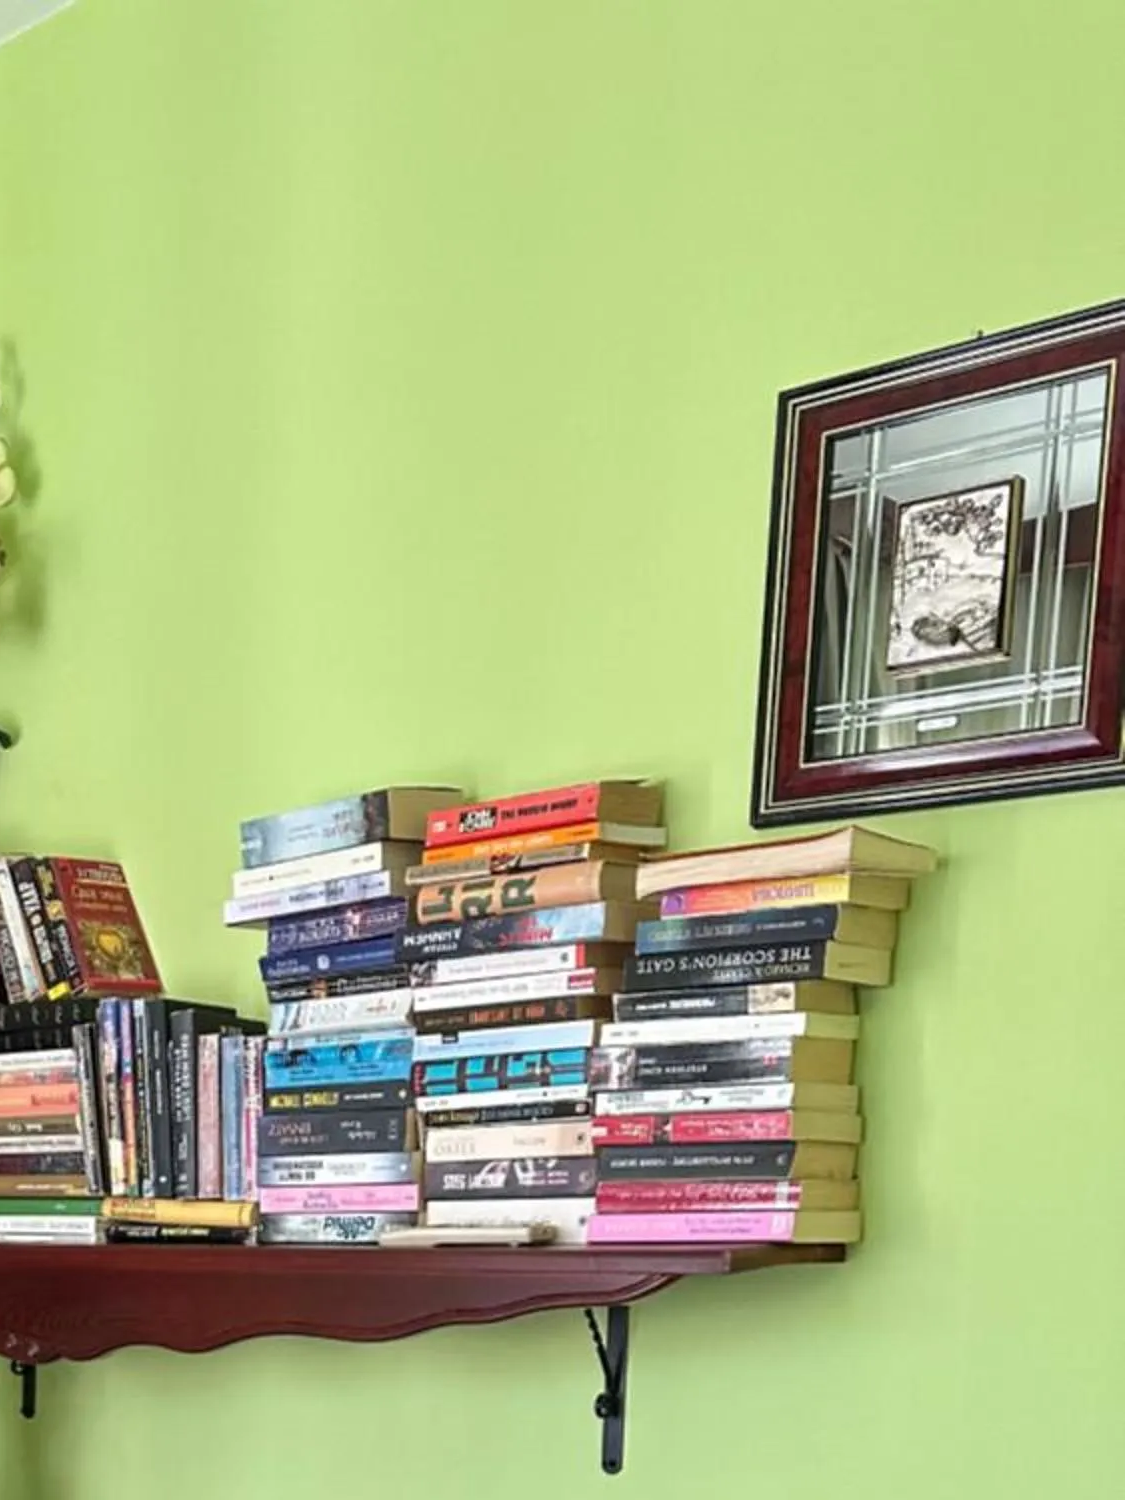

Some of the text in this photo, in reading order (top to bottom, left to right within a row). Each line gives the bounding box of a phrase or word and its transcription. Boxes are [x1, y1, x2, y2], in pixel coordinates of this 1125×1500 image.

[636, 945, 812, 975] THE SCORPION'S GATE
